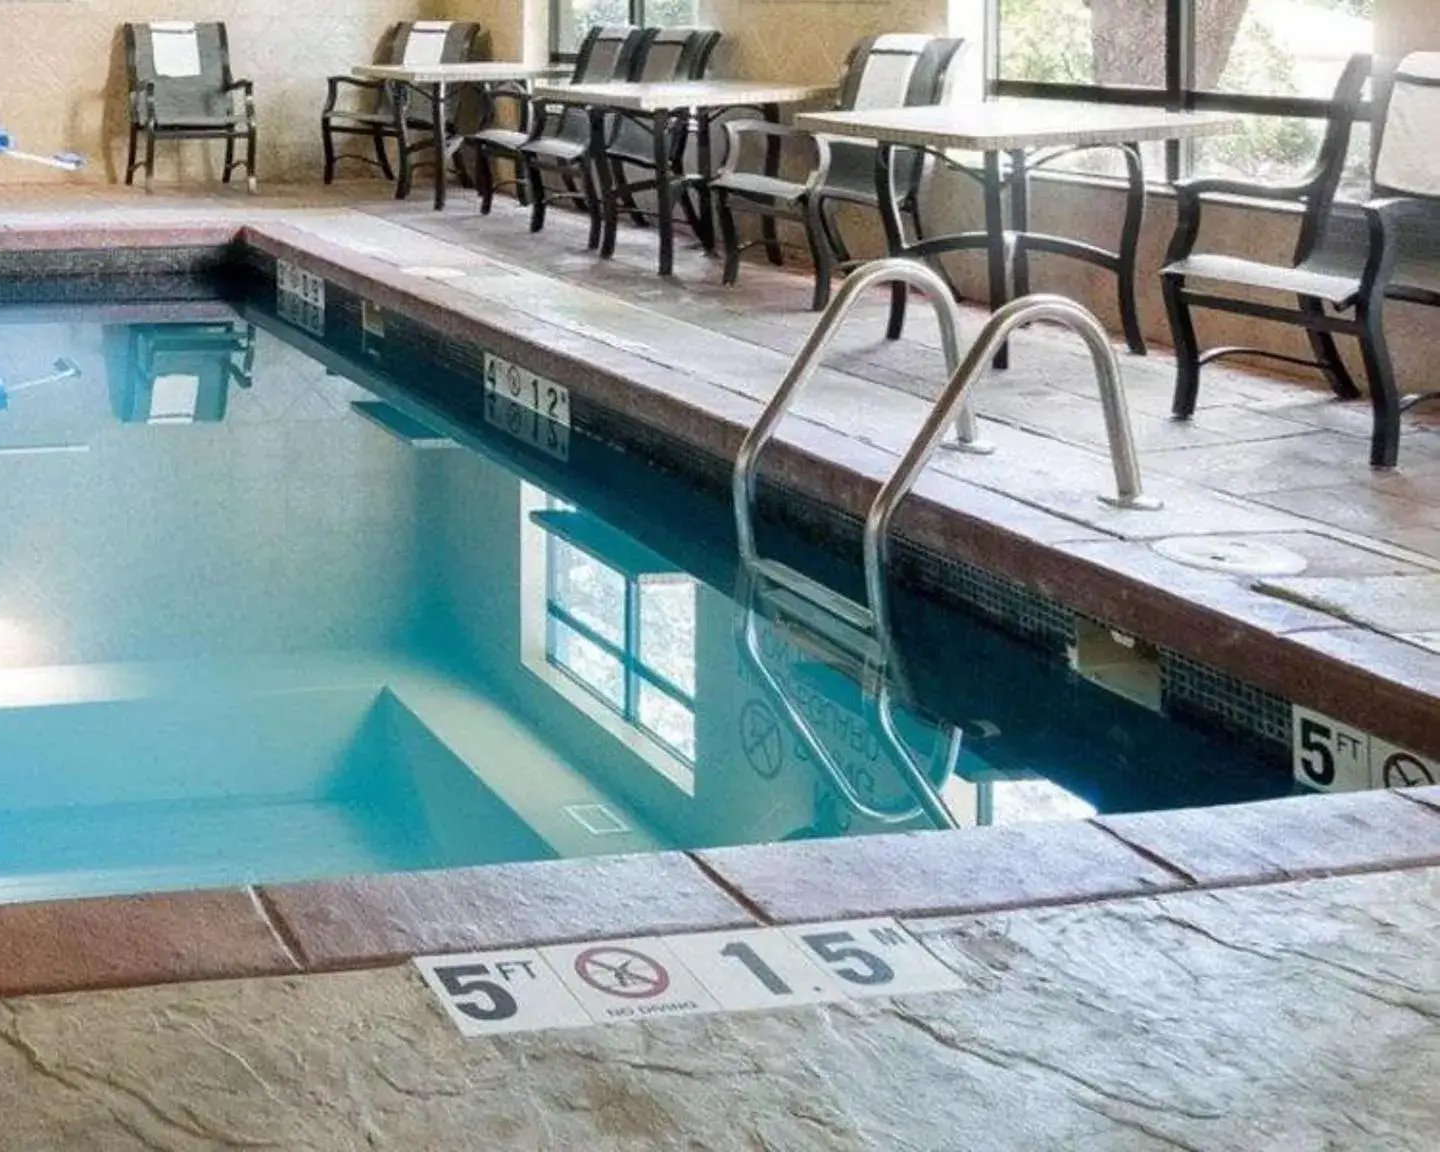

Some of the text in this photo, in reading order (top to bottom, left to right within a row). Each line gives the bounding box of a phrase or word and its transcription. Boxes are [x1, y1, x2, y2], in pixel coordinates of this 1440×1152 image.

[1301, 717, 1362, 786] 5 FT
[433, 964, 518, 1021] 5
[494, 959, 537, 981] FT
[868, 927, 907, 947] M
